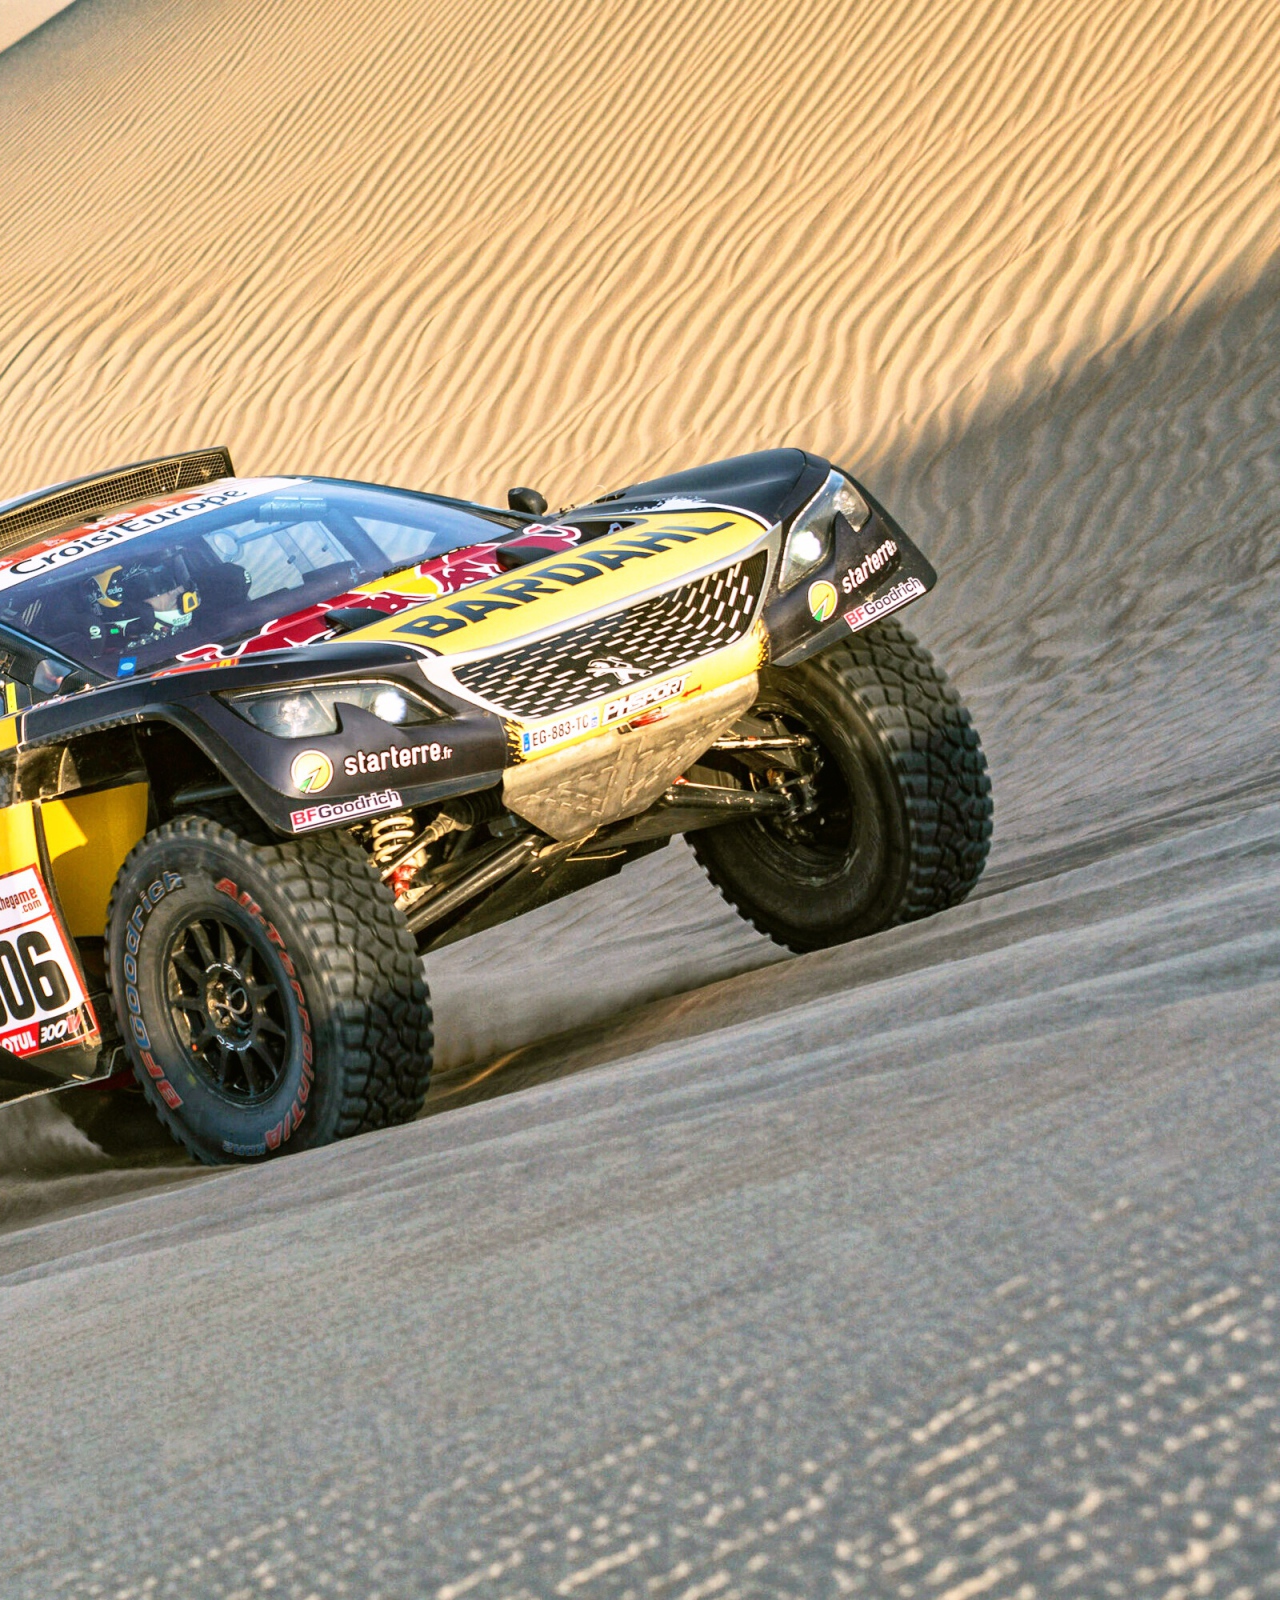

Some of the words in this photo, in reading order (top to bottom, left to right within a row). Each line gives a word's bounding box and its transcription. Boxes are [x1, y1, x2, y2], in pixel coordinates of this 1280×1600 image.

[9, 488, 248, 576] CroisiEurope
[391, 517, 737, 638] BARDAHL
[845, 577, 921, 626] BFGoodrich
[531, 717, 589, 748] EG-883-TC
[344, 741, 453, 776] starterre.fr
[292, 790, 400, 826] BFGoodrich
[21, 899, 43, 914] .com
[123, 870, 186, 1110] BFGoodrich
